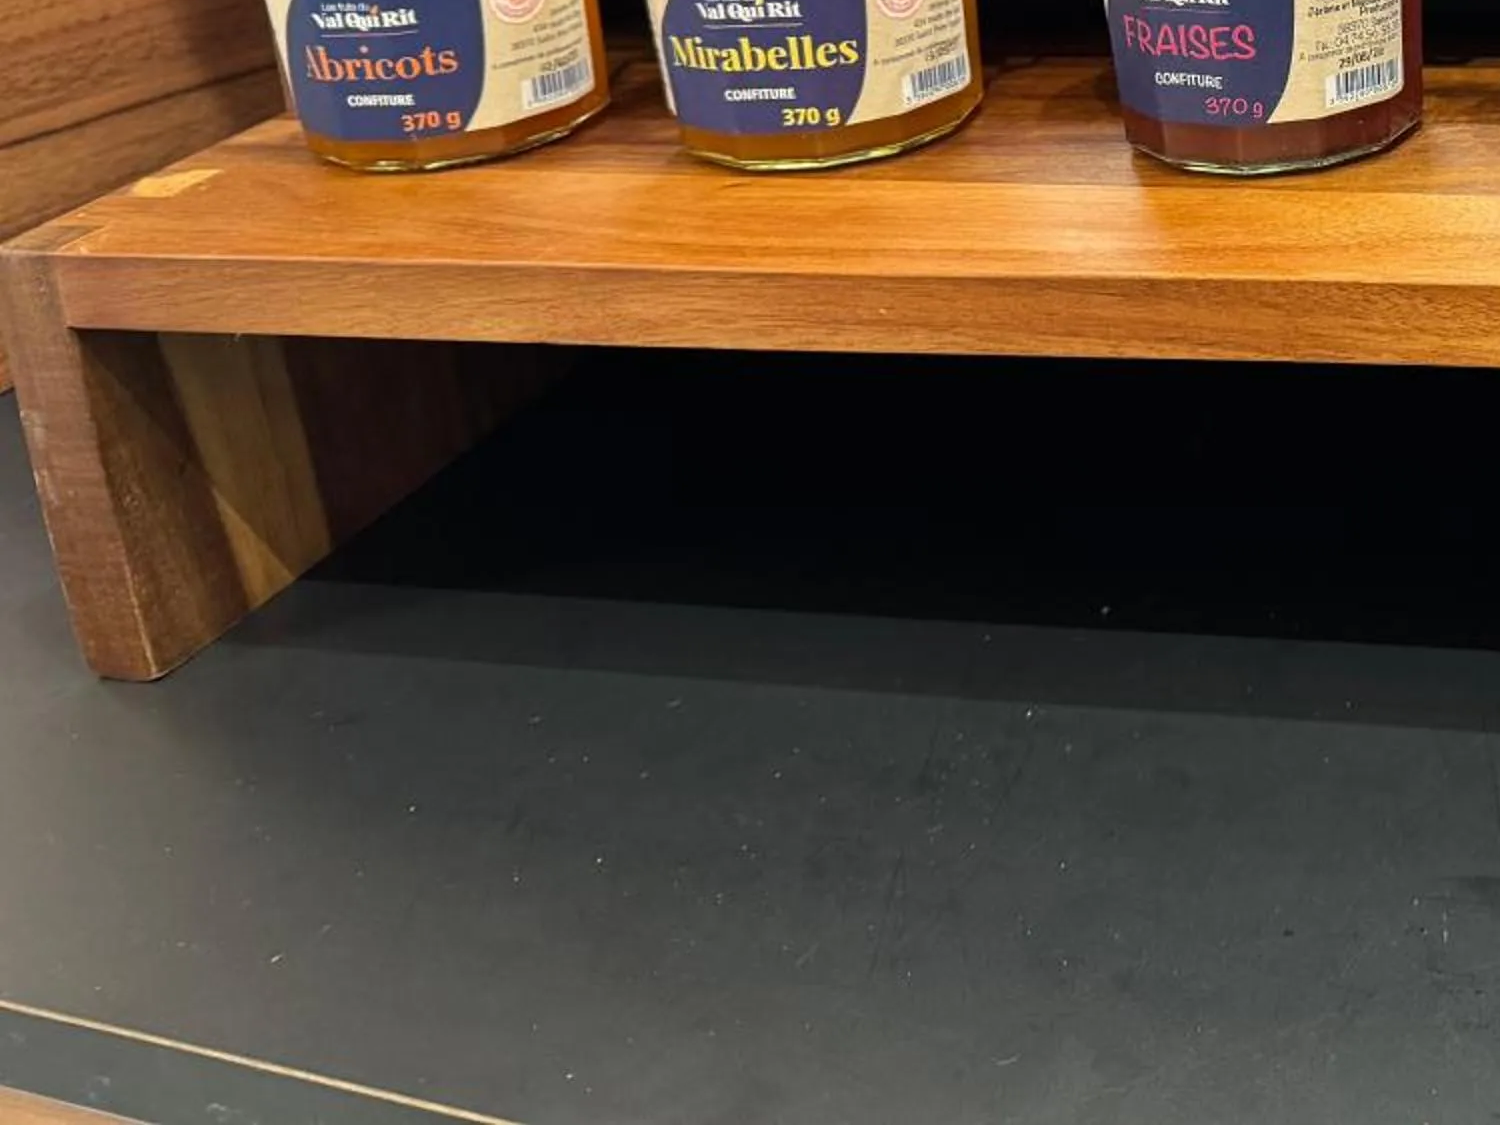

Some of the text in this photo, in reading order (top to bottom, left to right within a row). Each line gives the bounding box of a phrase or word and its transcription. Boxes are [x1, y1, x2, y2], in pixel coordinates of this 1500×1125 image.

[1123, 14, 1256, 60] FRAISES
[305, 45, 459, 83] Abricots
[669, 35, 859, 72] Mirabelles
[1155, 72, 1223, 90] CONFITURE
[347, 94, 415, 108] CONFITURE
[724, 88, 796, 102] CONFITURE
[782, 107, 840, 126] 370 g
[1204, 96, 1265, 119] 370 g
[401, 111, 461, 132] 370 g
